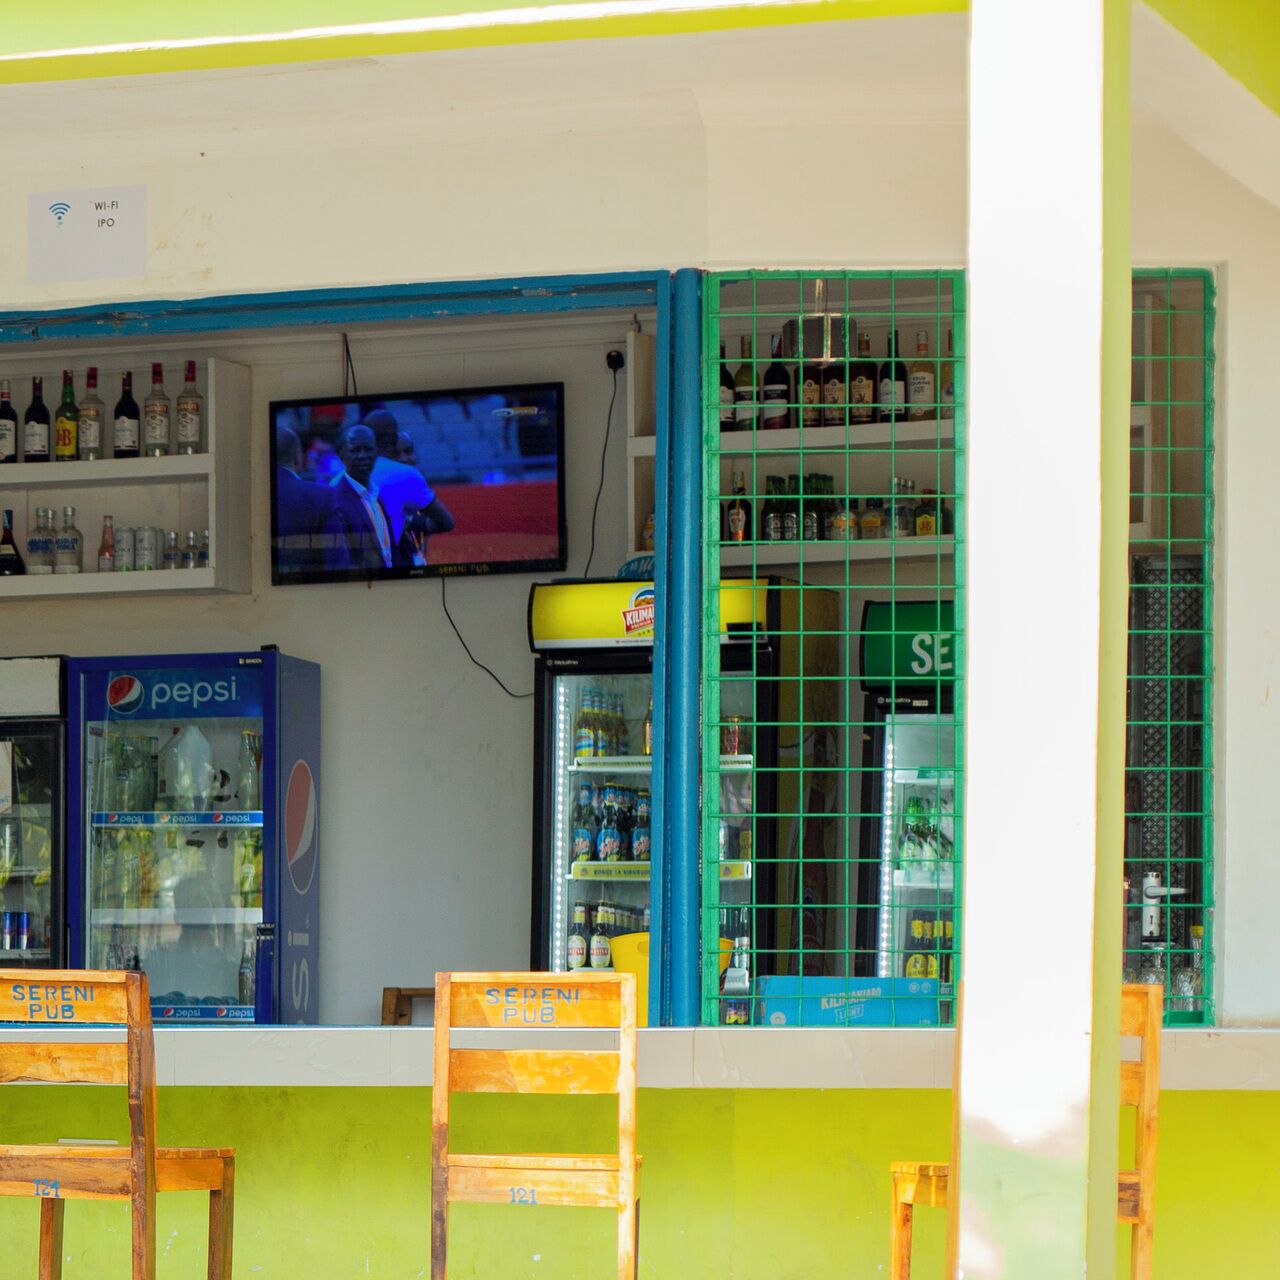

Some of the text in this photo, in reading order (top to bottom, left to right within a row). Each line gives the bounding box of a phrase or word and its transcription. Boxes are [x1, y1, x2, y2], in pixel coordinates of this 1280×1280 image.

[94, 200, 119, 211] WI-FI
[97, 217, 115, 228] IPO
[625, 606, 654, 627] KILIMA
[911, 633, 953, 675] SE
[151, 676, 238, 709] pepsi
[225, 813, 250, 823] pepsi
[12, 984, 95, 1002] SERENI
[485, 987, 580, 1005] SERENI
[28, 1003, 76, 1020] PUB
[176, 1008, 201, 1018] pepsi
[228, 1007, 255, 1018] pepsi
[503, 1006, 556, 1025] PUB
[509, 1187, 538, 1205] 121
